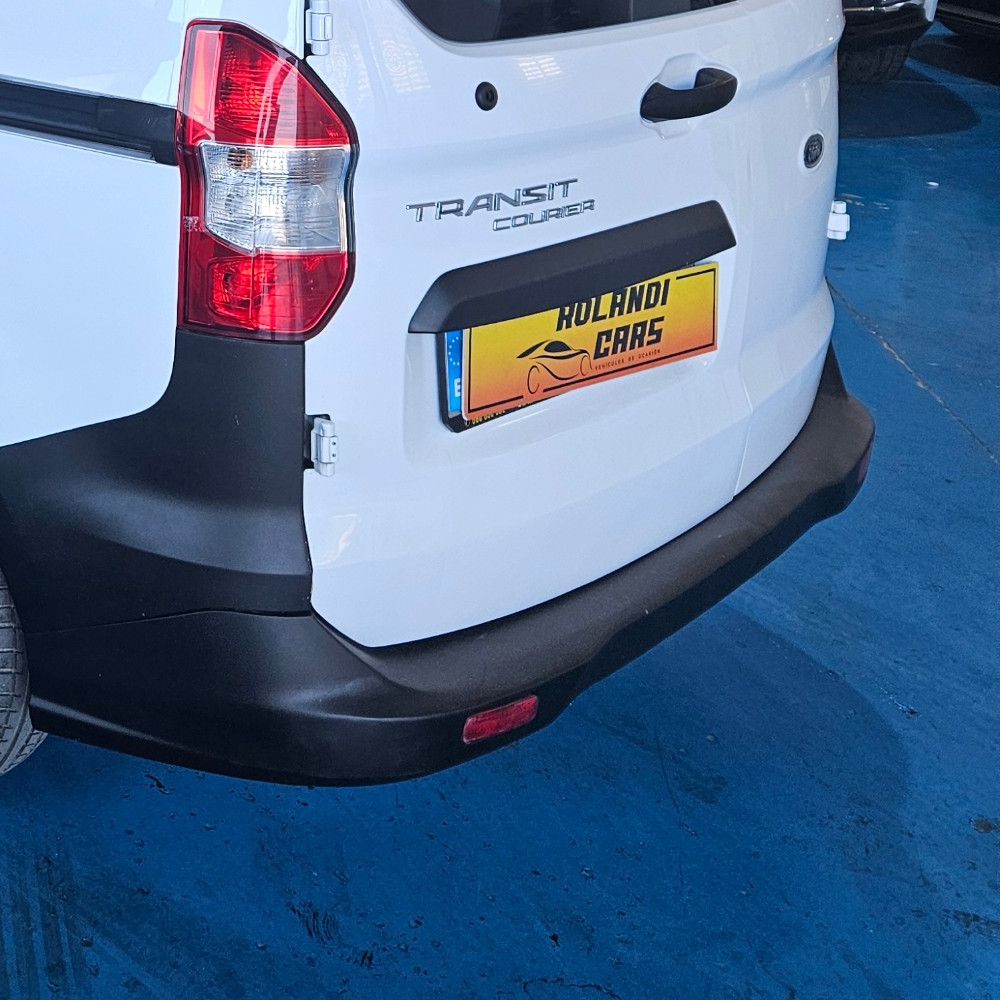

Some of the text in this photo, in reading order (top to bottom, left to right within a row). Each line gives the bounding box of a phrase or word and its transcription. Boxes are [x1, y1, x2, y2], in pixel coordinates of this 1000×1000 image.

[405, 178, 578, 222] TRANSIT
[492, 199, 595, 232] COURIER
[556, 279, 670, 332] ROLANDI
[593, 315, 665, 360] CARS
